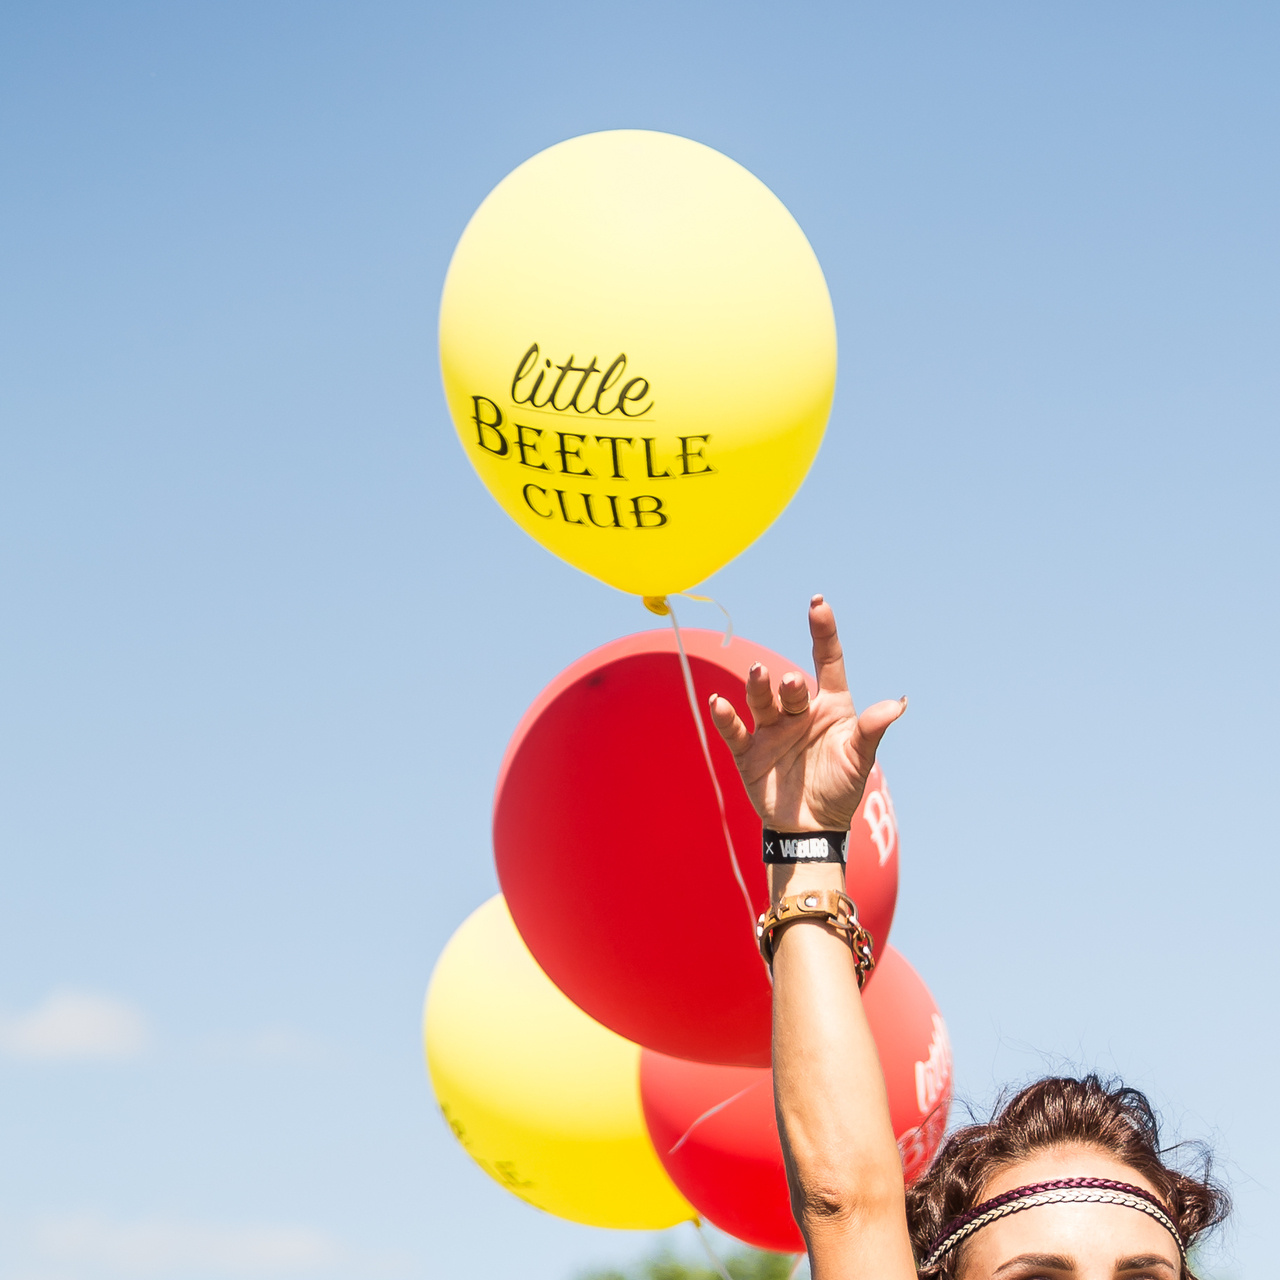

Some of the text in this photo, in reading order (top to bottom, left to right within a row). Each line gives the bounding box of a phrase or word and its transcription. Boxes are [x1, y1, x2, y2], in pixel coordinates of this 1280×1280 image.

[511, 342, 654, 417] little
[470, 395, 715, 479] BEETLE
[522, 483, 669, 529] CLUB
[779, 838, 829, 858] VAGBURG
